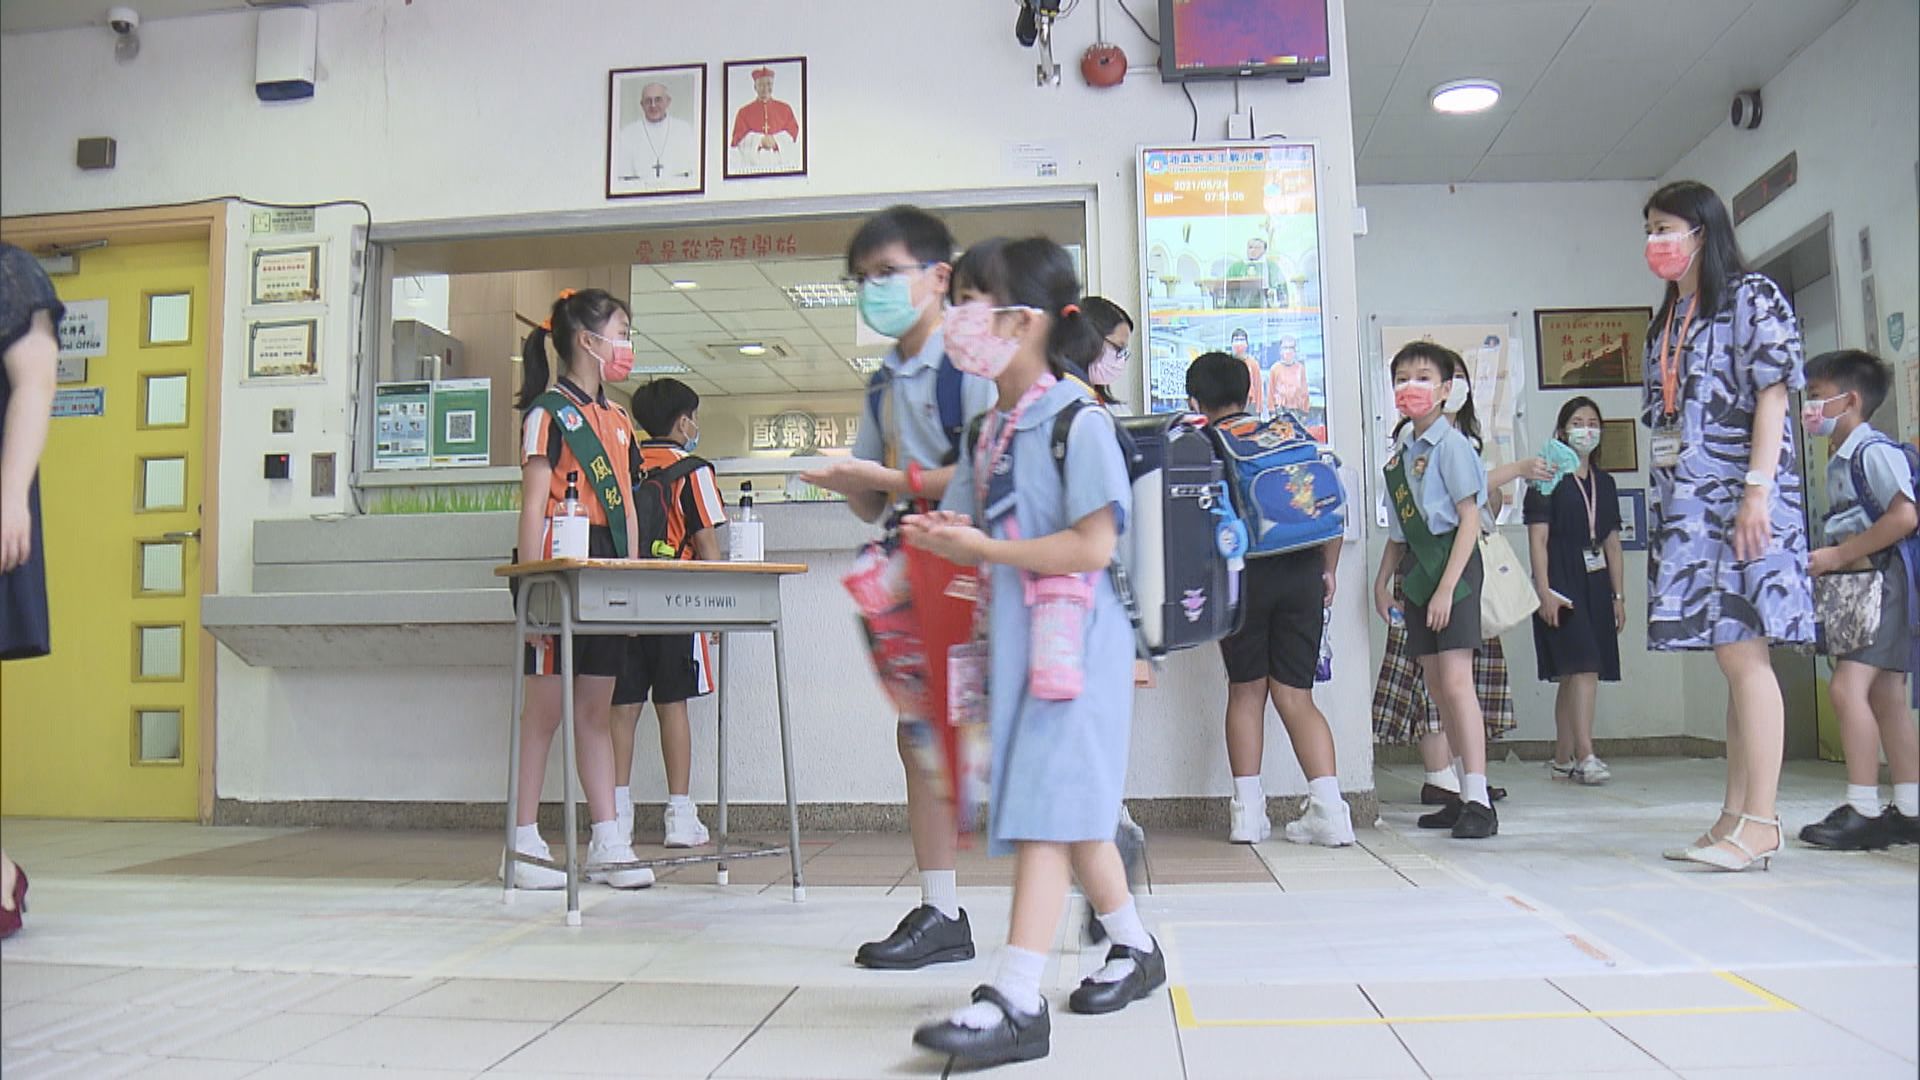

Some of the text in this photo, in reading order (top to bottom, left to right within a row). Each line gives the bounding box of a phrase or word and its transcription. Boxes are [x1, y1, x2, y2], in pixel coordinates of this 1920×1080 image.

[636, 232, 797, 264] 愛是從家庭開始
[590, 456, 622, 510] 風紀
